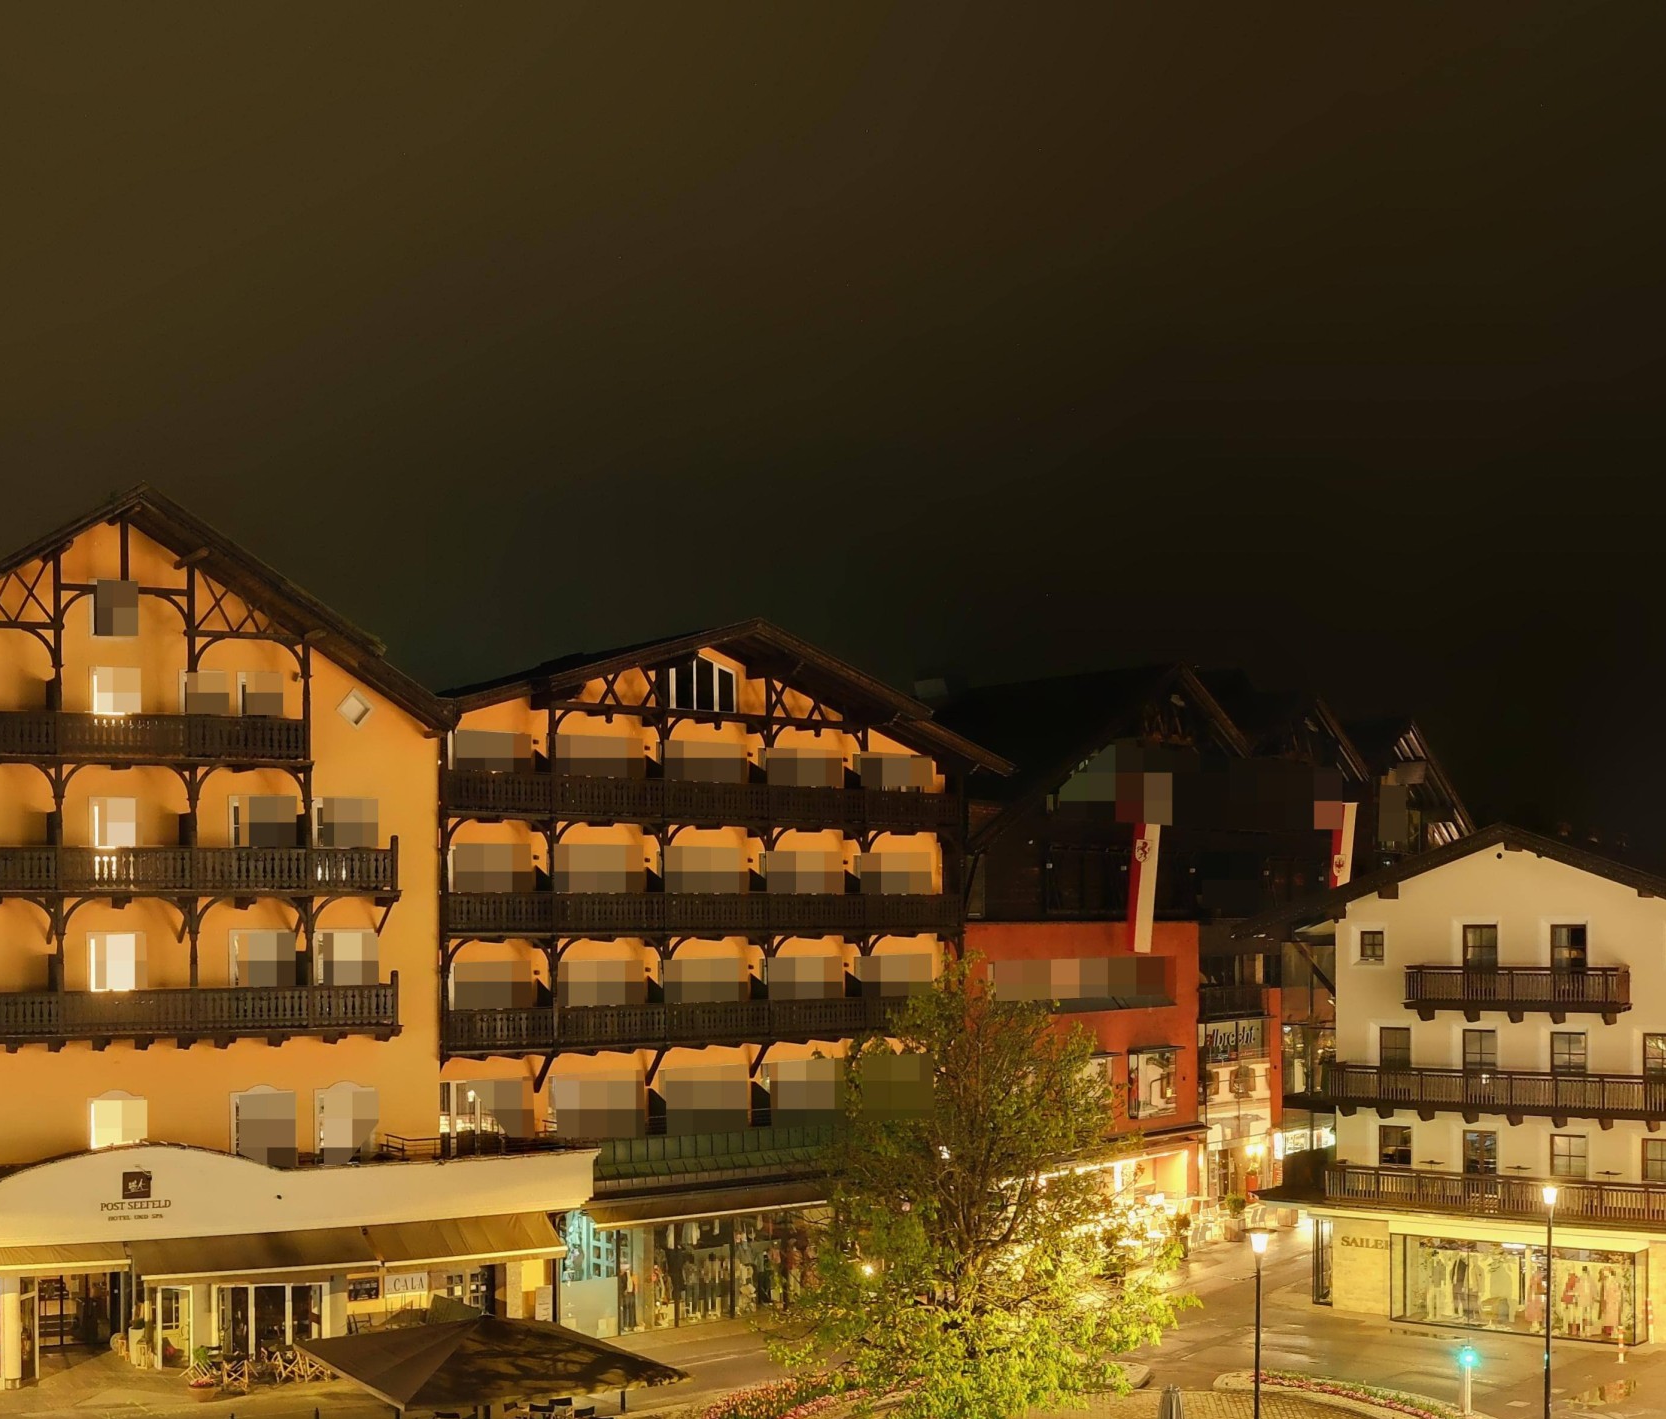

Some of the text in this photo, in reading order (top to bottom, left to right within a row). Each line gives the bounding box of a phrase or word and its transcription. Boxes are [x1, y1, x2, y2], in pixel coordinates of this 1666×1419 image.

[100, 1199, 171, 1211] POST SEEFELD
[393, 1276, 424, 1292] CALA
